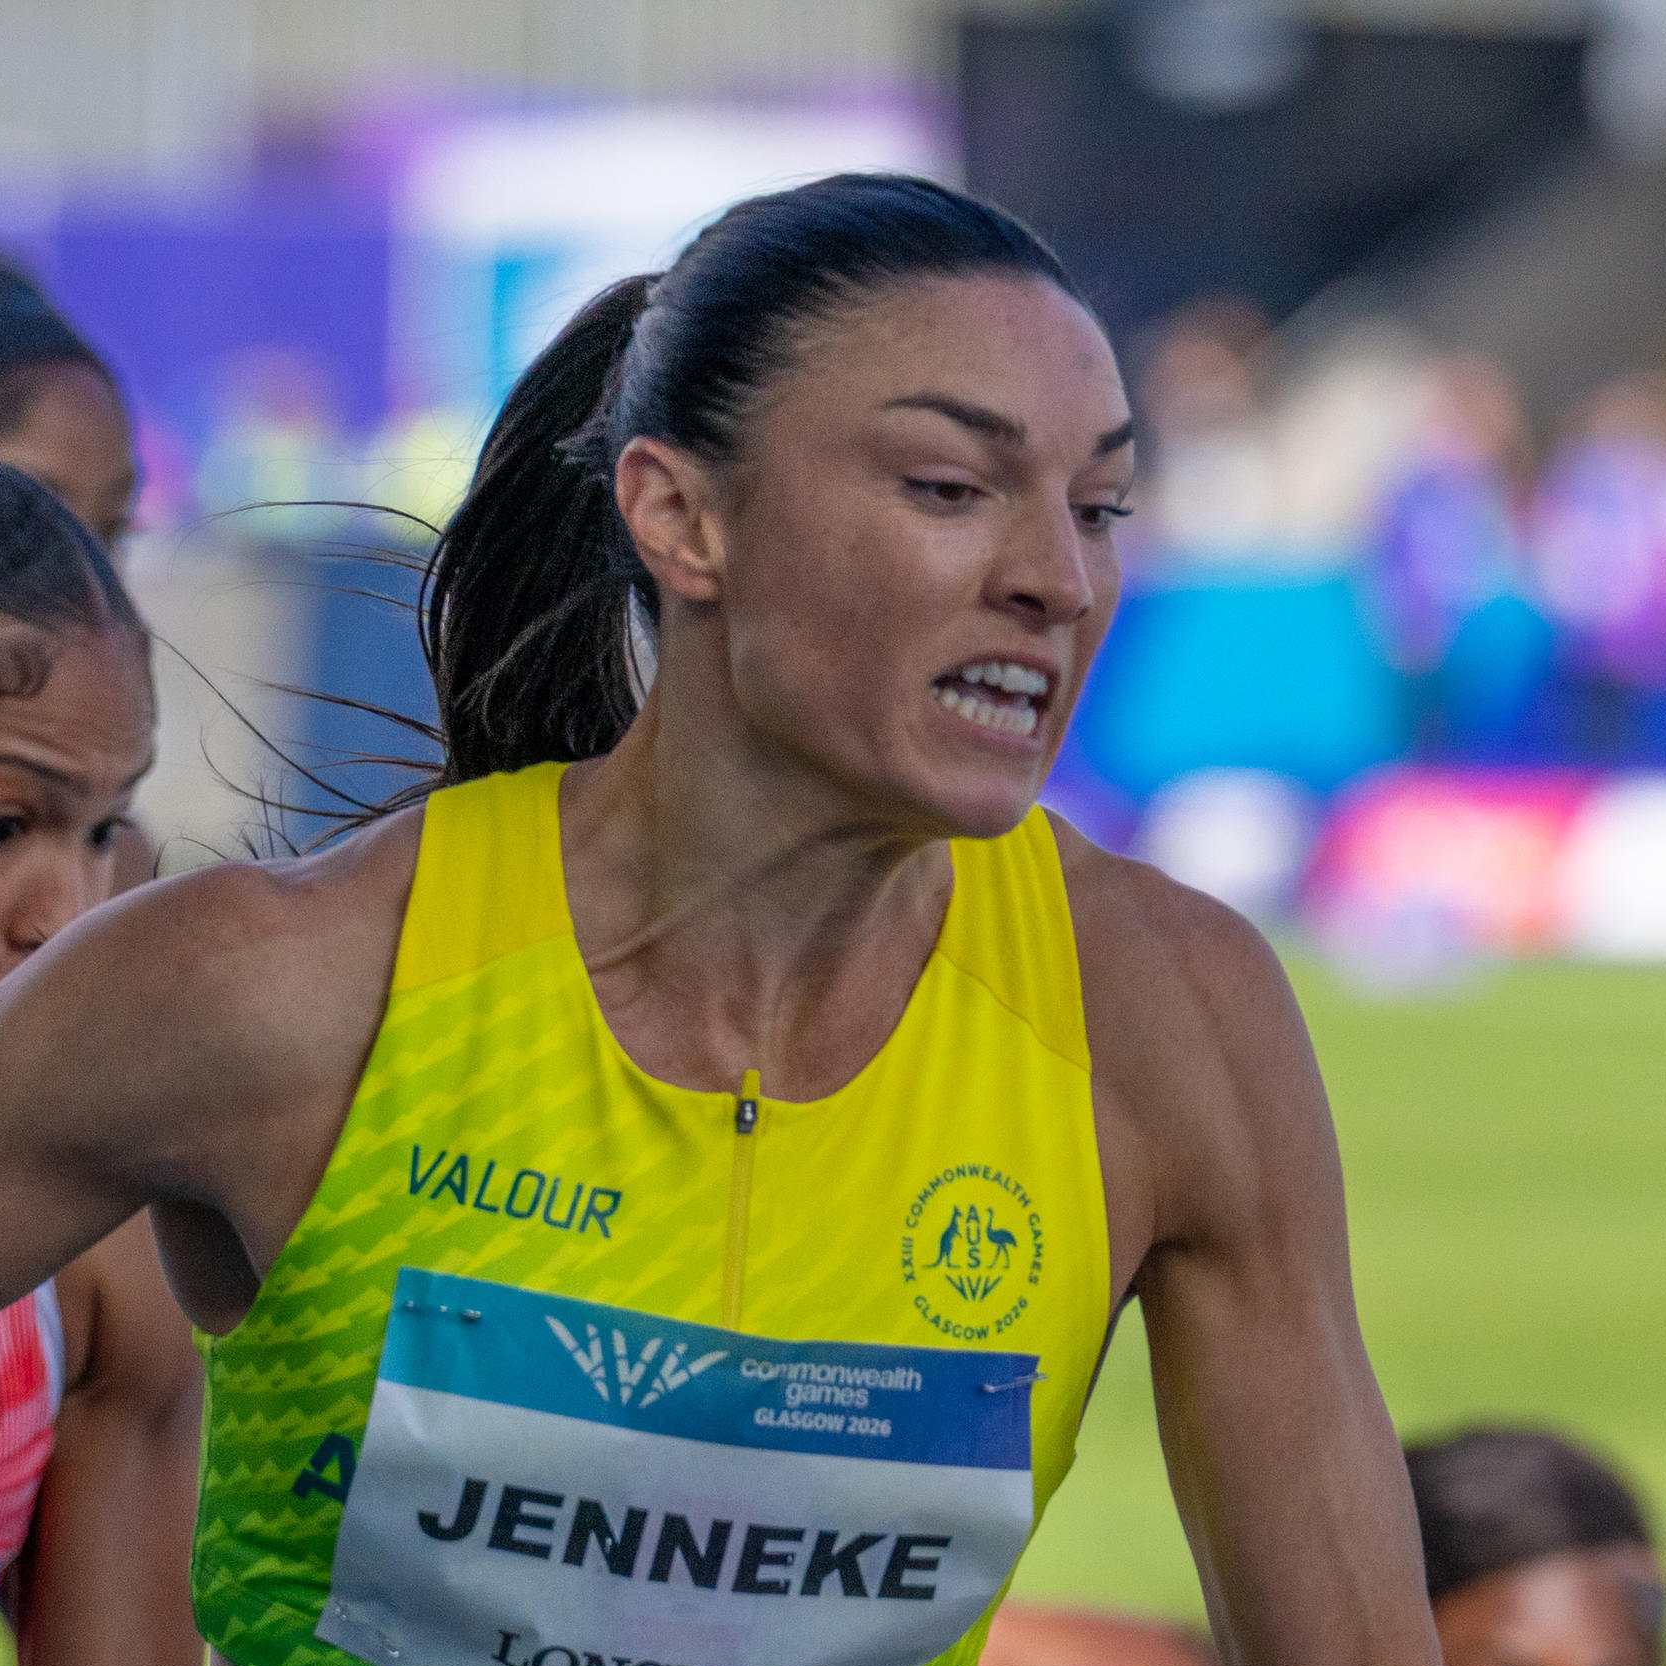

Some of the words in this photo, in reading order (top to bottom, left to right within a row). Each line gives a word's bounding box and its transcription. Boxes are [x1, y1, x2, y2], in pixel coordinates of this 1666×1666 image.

[409, 1143, 623, 1239] VALOUR
[906, 1164, 1031, 1229] COMMONWEALTH
[901, 1236, 917, 1284] XXIII
[1028, 1213, 1044, 1285] GAMES
[914, 1295, 989, 1340] GLASGOW
[995, 1296, 1029, 1334] 2026
[740, 1358, 923, 1392] commonwealth
[785, 1382, 870, 1409] games
[753, 1407, 845, 1433] GLASGOW
[847, 1415, 892, 1438] 2026
[416, 1477, 952, 1601] JENNEKE
